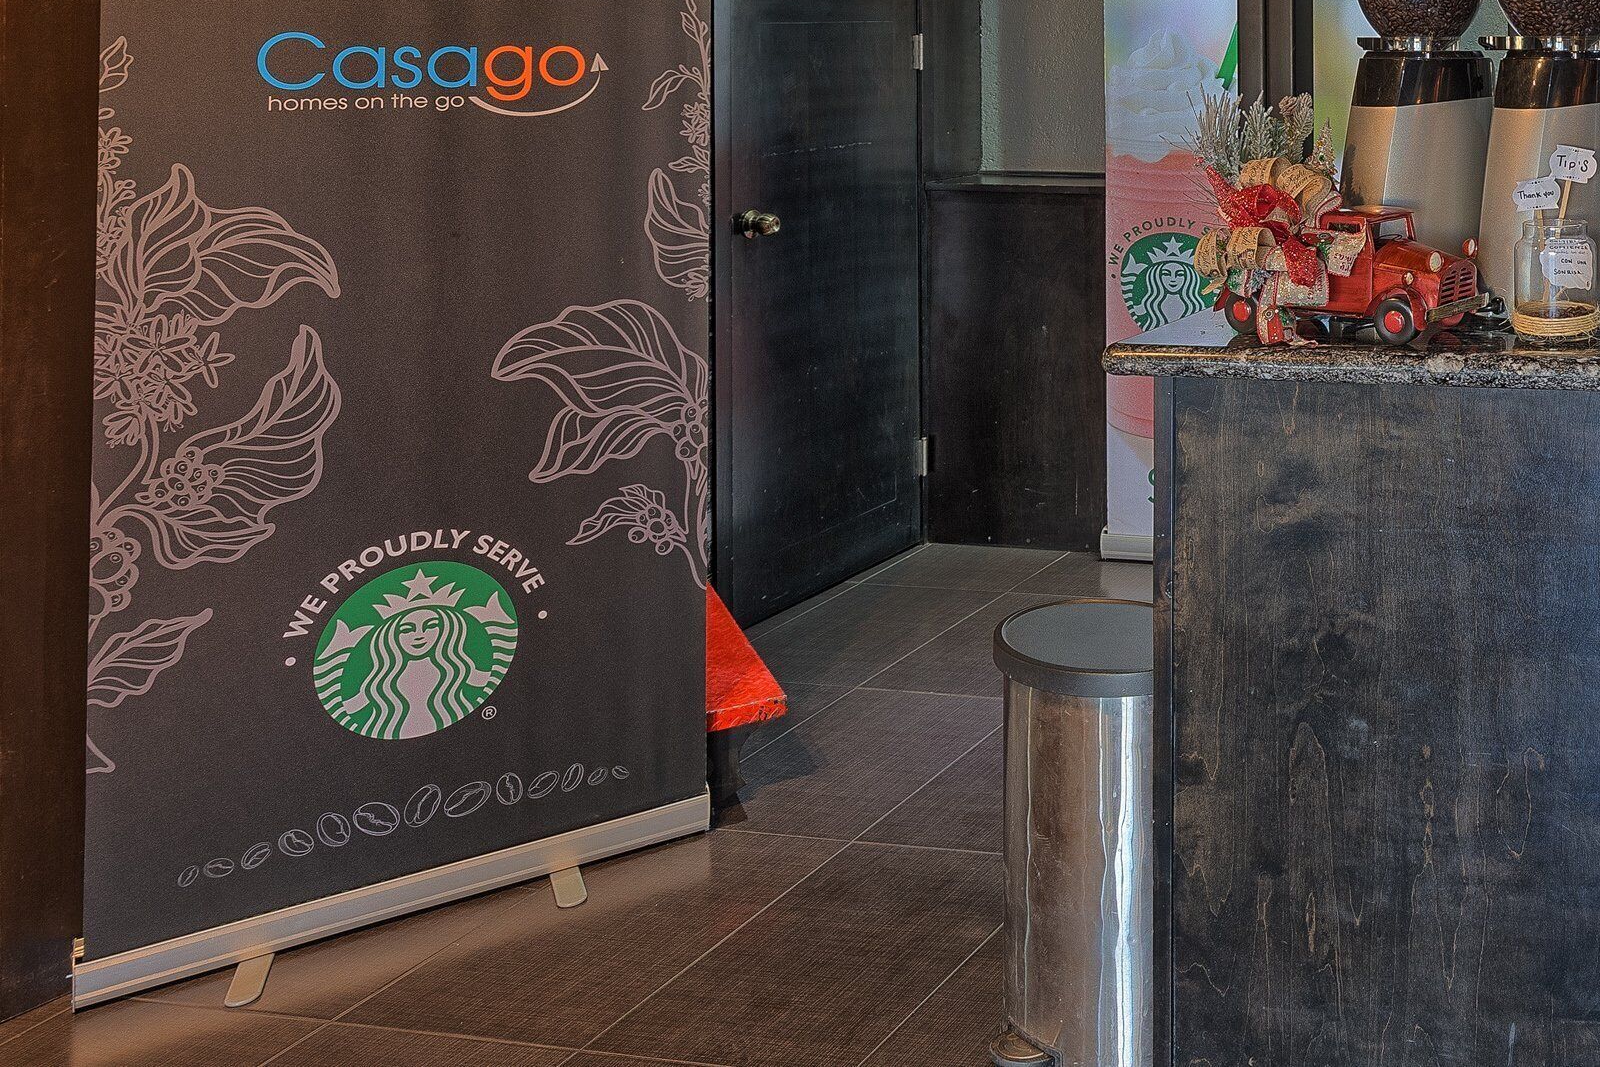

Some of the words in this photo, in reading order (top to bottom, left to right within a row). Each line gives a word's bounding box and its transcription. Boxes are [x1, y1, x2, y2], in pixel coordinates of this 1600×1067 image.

[256, 31, 587, 102] Casago
[267, 92, 348, 112] homes
[354, 97, 385, 111] on
[391, 91, 428, 112] the
[433, 97, 466, 115] go
[1518, 191, 1543, 199] Thank
[1108, 243, 1124, 266] WE
[1122, 216, 1196, 242] PROUDLY
[282, 593, 328, 640] WE
[320, 529, 471, 594] PROUDLY
[472, 534, 546, 594] SERVE
